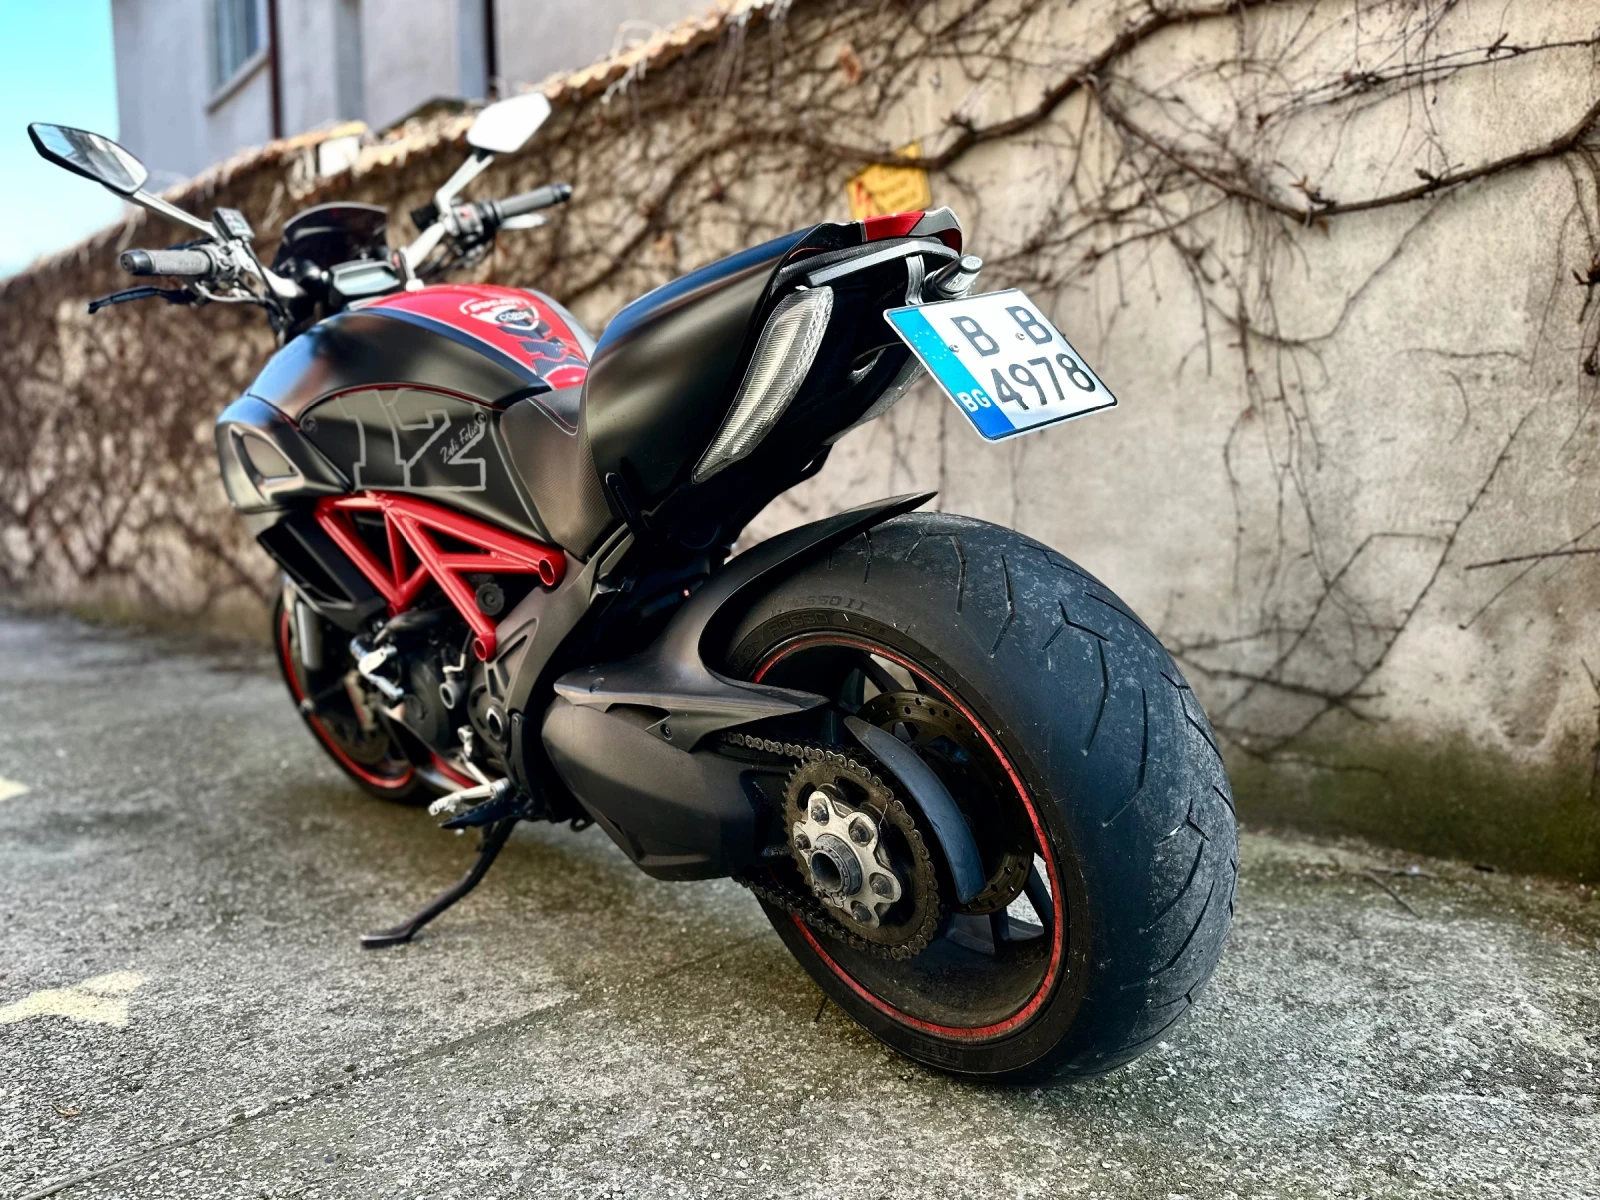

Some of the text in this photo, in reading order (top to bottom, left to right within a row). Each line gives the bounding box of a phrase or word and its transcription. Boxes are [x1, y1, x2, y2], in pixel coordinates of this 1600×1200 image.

[950, 306, 1053, 358] B B
[956, 389, 992, 412] BG
[990, 353, 1096, 411] 4978
